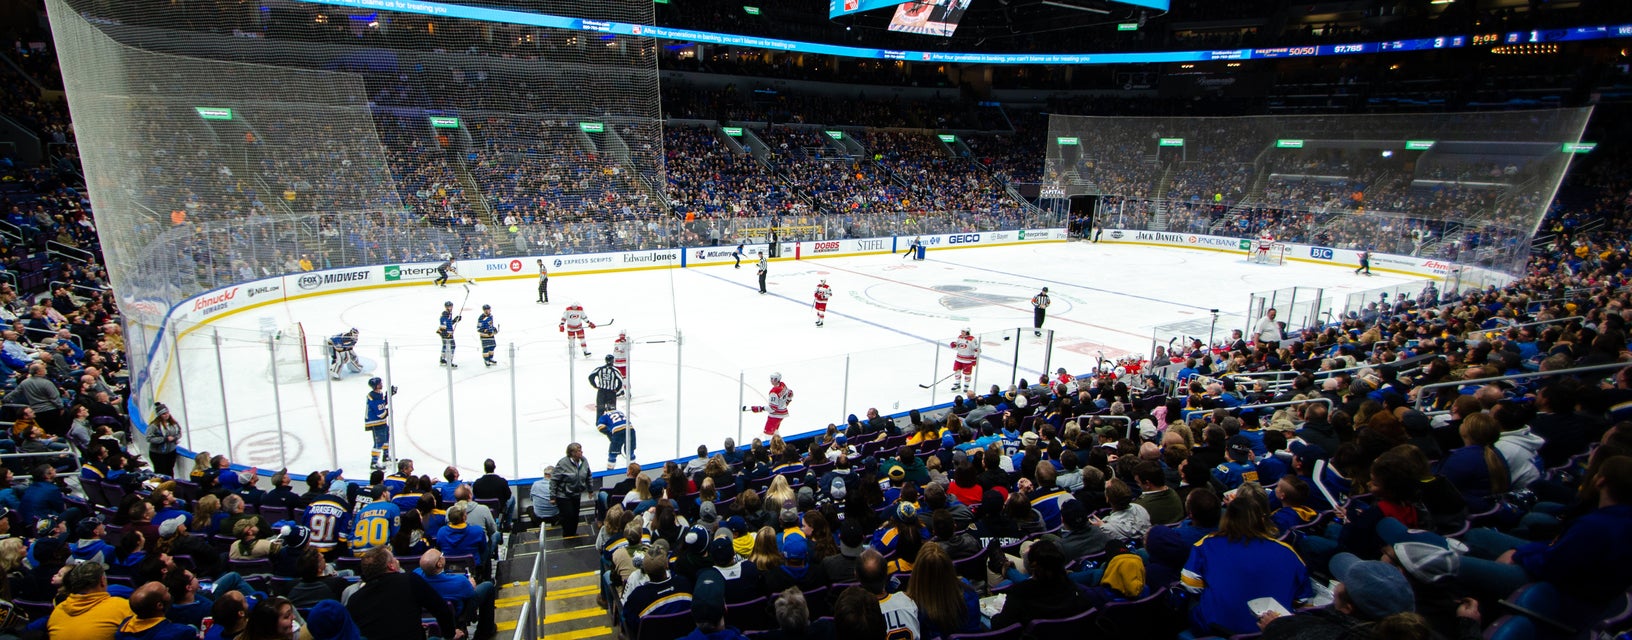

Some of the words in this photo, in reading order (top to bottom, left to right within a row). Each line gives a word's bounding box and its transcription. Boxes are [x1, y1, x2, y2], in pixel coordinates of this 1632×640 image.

[407, 3, 433, 13] treating
[643, 27, 656, 35] After
[668, 30, 697, 39] generations
[744, 38, 757, 46] blame
[771, 40, 787, 49] treating
[1472, 34, 1498, 43] 9:05
[1529, 31, 1539, 42] 1
[1434, 38, 1444, 48] 3
[1289, 47, 1314, 56] 50/50
[948, 233, 980, 244] GEICO
[1135, 231, 1152, 240] JACK
[814, 241, 840, 250] DOBBS
[857, 239, 885, 251] STIFEL
[1198, 237, 1215, 245] PNC
[1216, 239, 1238, 247] BANK
[1312, 248, 1331, 258] BJC
[588, 256, 613, 264] SCRIPTS
[486, 263, 508, 271] BMO
[302, 275, 317, 284] FOX
[323, 270, 370, 284] MIDWEST
[192, 287, 238, 312] Schnucks
[310, 514, 336, 542] 91
[353, 517, 389, 547] 90
